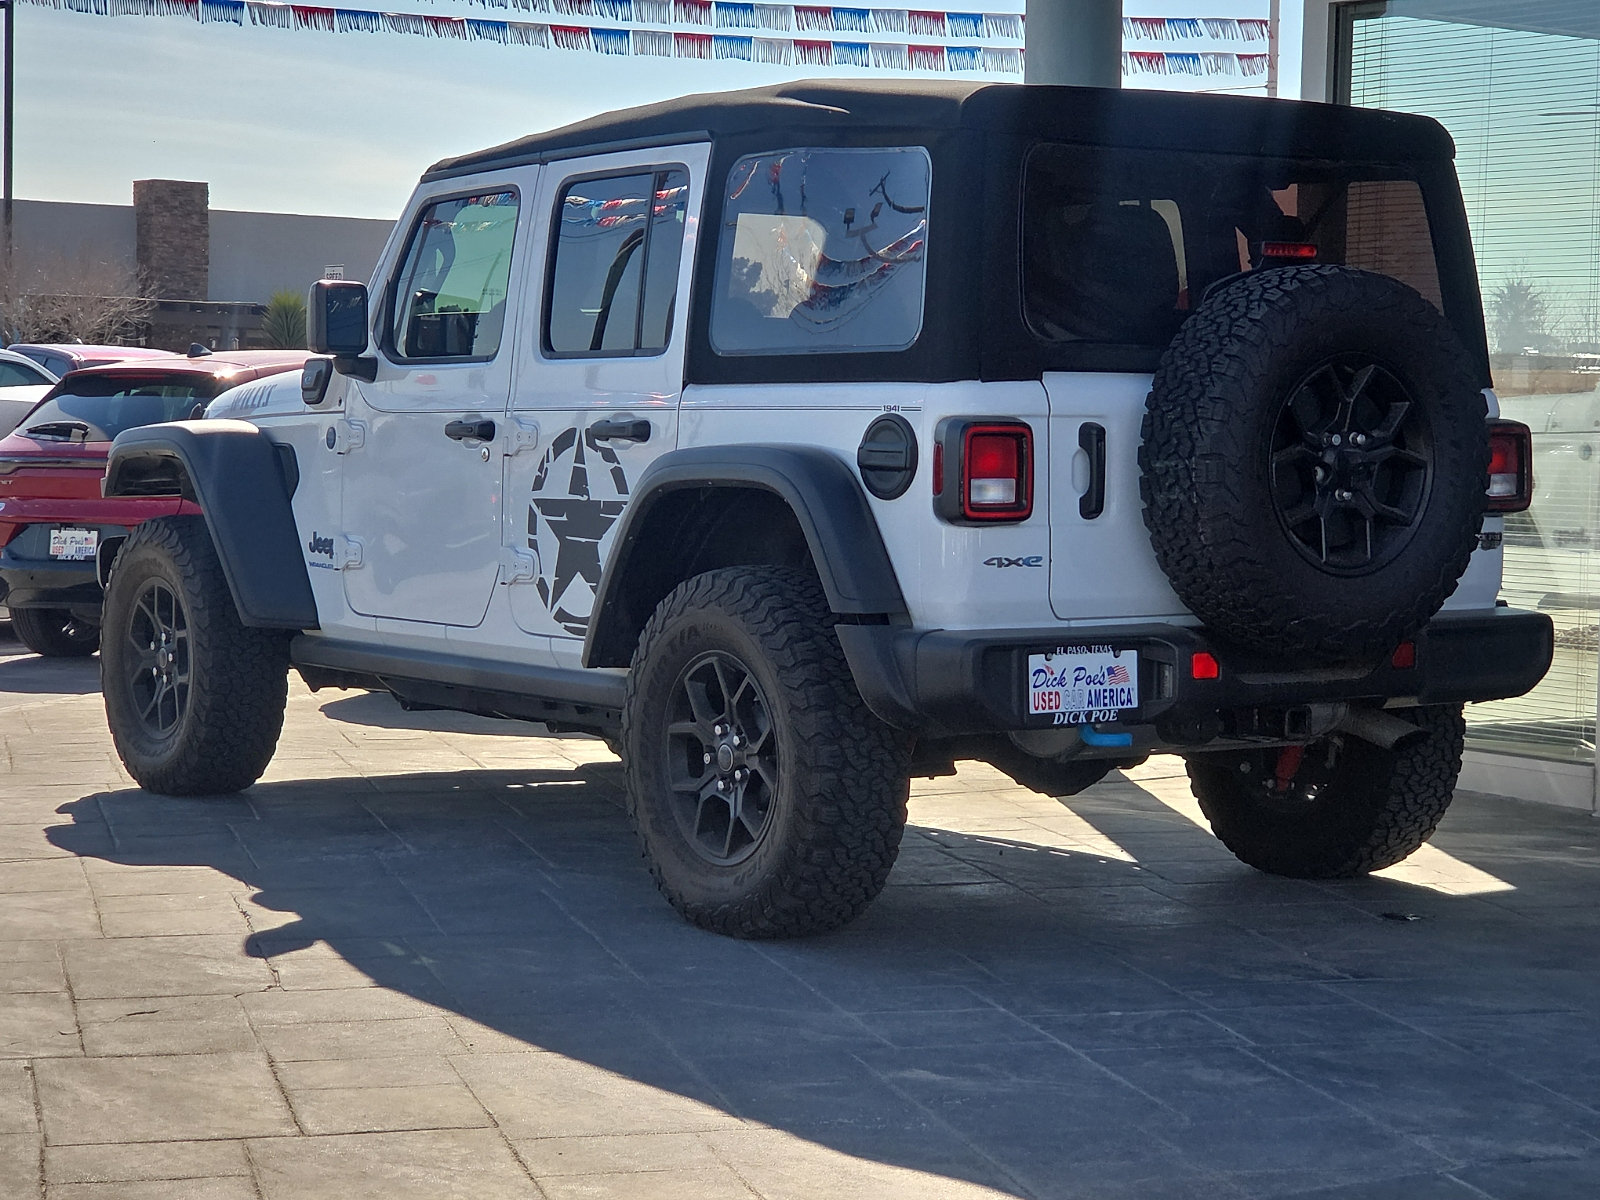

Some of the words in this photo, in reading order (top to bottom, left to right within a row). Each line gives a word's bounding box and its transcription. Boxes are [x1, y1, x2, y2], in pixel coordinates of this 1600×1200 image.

[309, 531, 334, 559] Jeep
[1056, 646, 1064, 655] EL
[1091, 645, 1112, 654] TEXAS
[1032, 667, 1068, 689] Dick
[1073, 665, 1107, 688] Poe's
[1033, 690, 1061, 711] USED
[1064, 689, 1085, 710] CAR
[1086, 687, 1133, 708] AMERICA
[1052, 711, 1088, 725] DICK
[1090, 709, 1119, 722] POE
